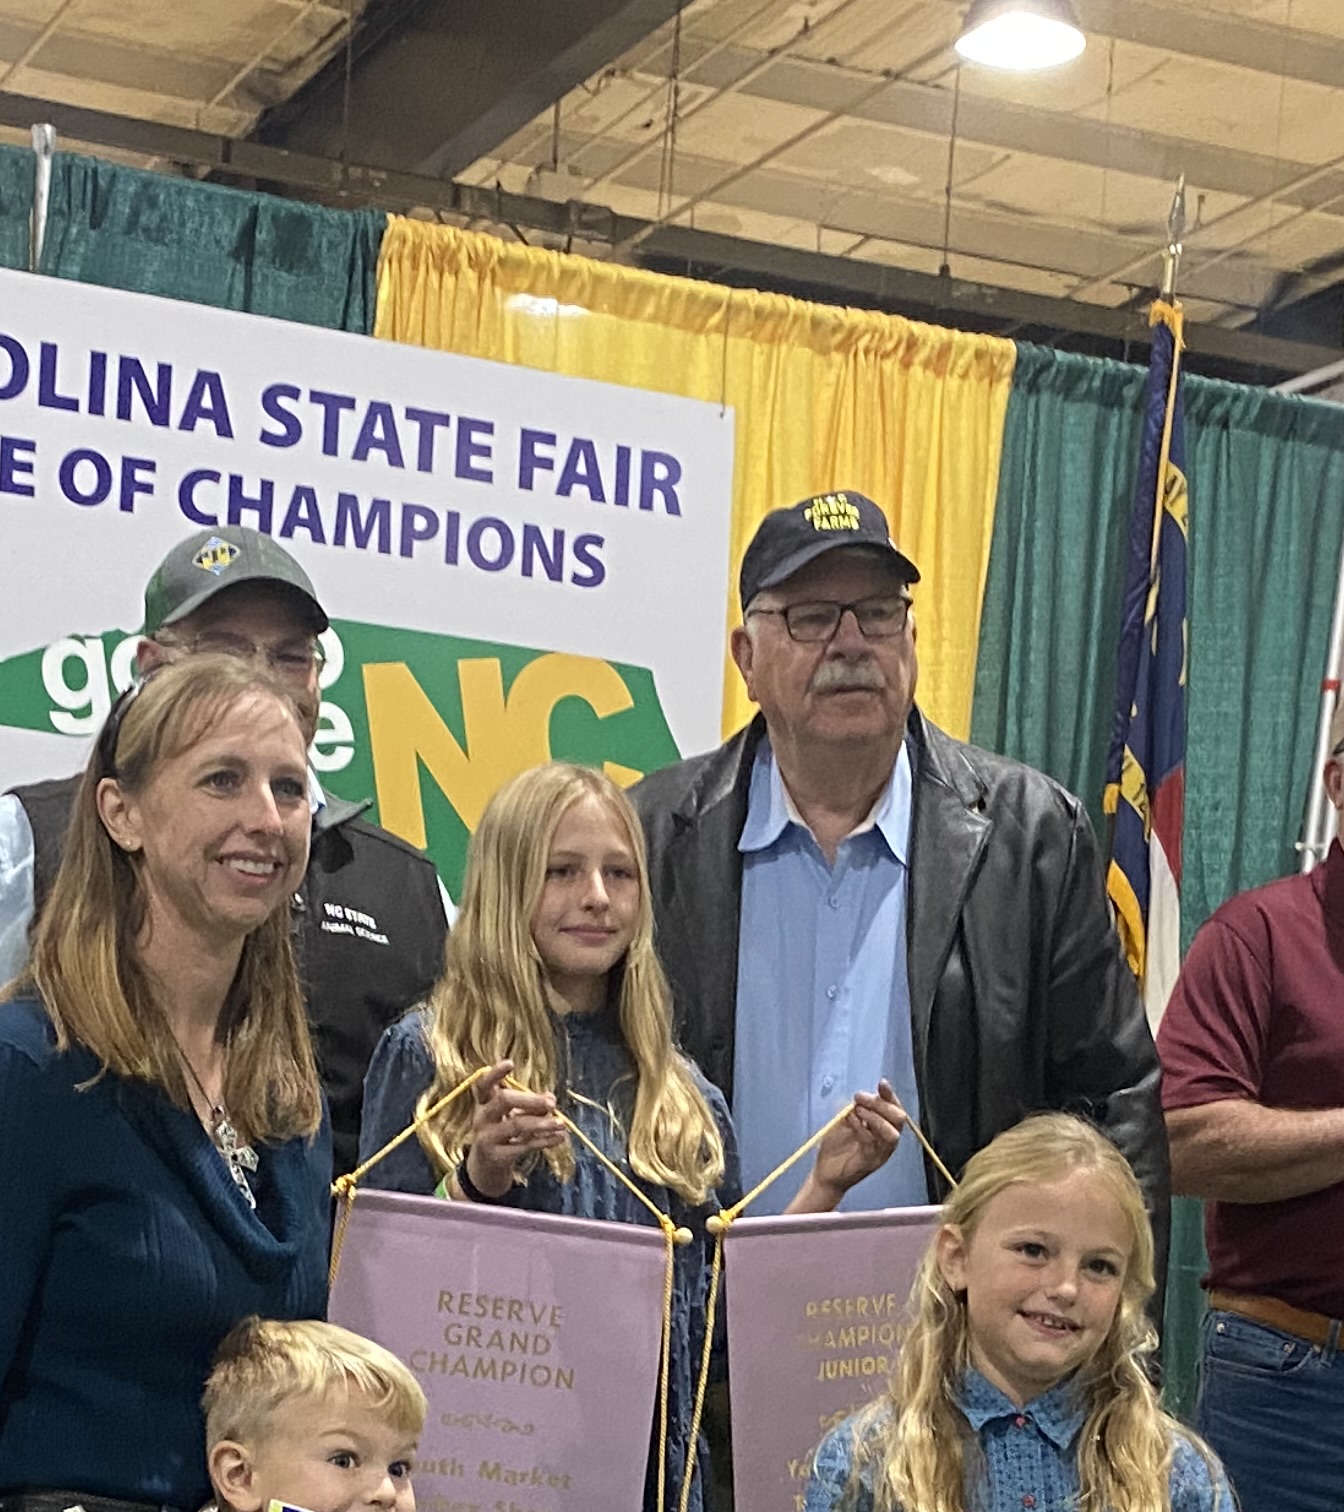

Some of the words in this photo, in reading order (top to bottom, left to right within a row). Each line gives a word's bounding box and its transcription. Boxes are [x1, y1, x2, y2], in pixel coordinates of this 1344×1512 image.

[258, 383, 494, 484] STATE
[518, 428, 683, 518] FAIR
[59, 447, 161, 512] OF
[178, 469, 606, 588] CHAMPIONS
[362, 654, 643, 850] NC
[436, 1289, 564, 1328] RESERVE
[806, 1293, 896, 1317] RESERVE
[442, 1323, 552, 1356] GRAND
[409, 1349, 576, 1390] CHAMPION
[817, 1355, 889, 1382] JUNIOR
[478, 1460, 573, 1490] Market
